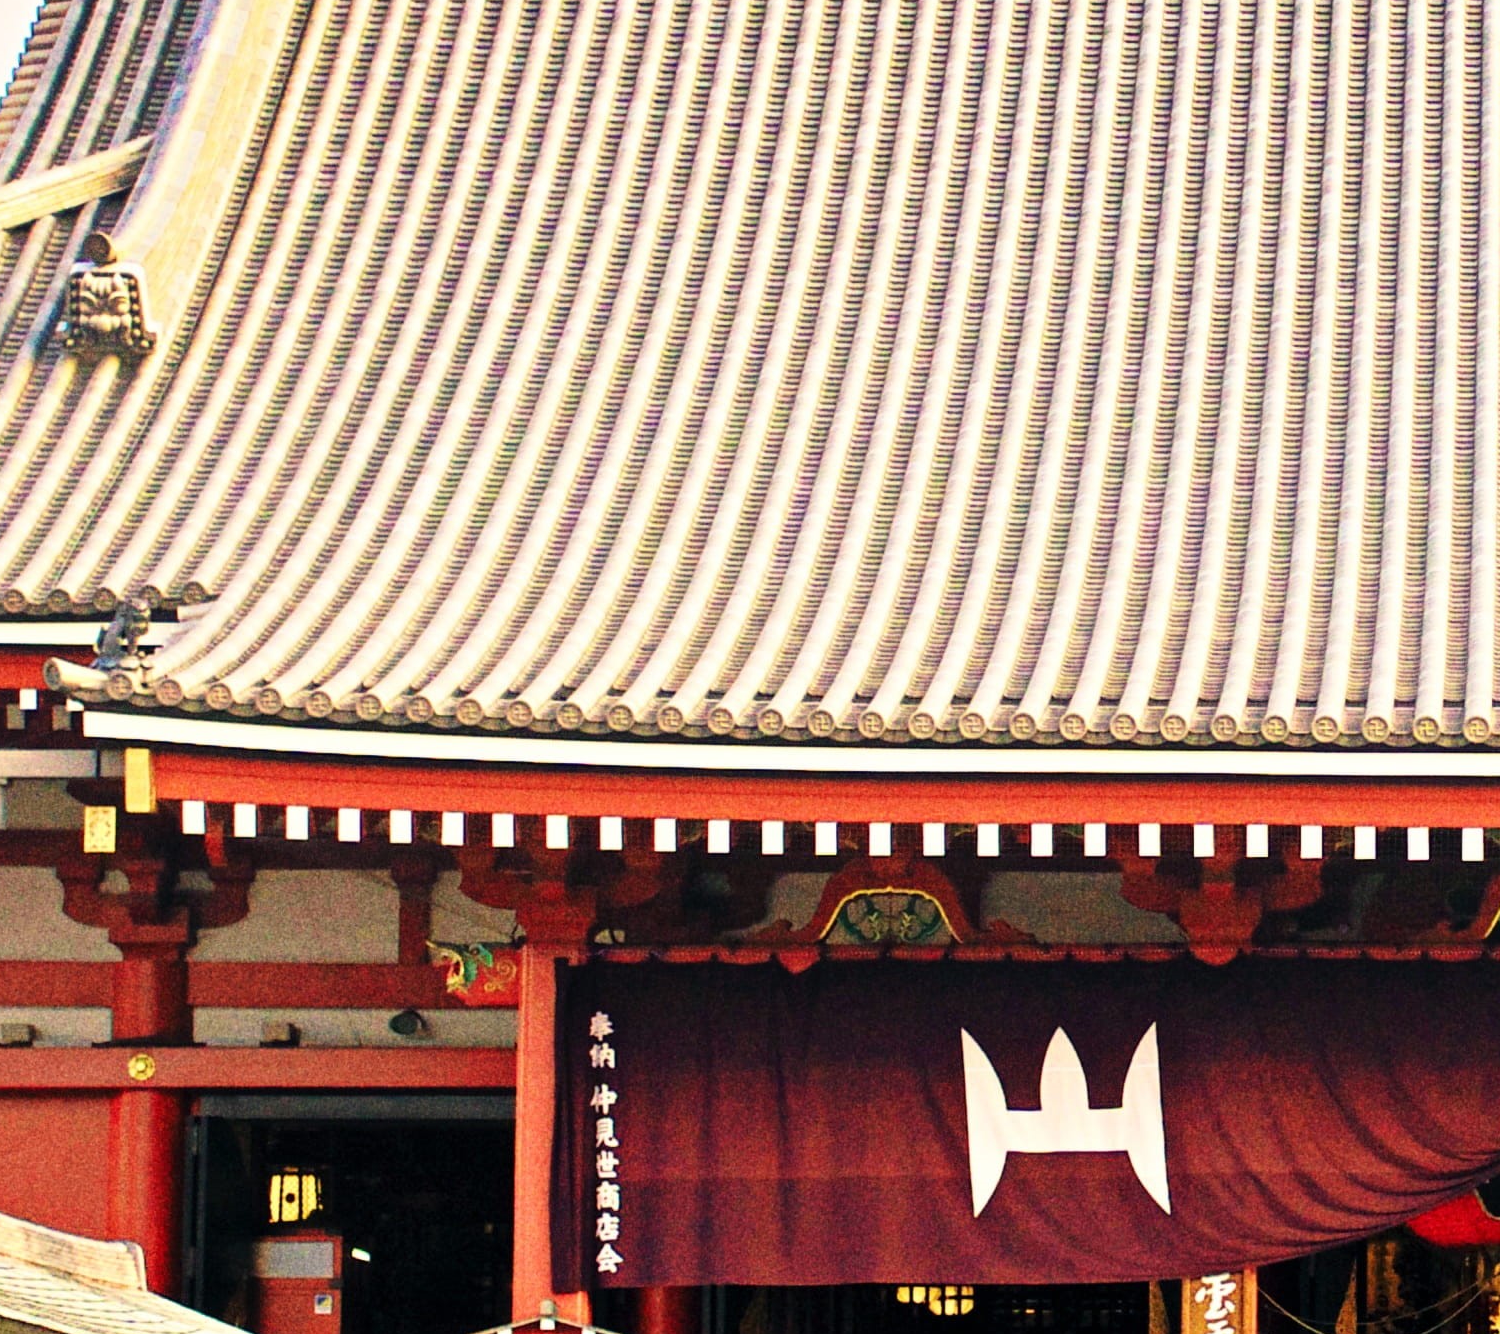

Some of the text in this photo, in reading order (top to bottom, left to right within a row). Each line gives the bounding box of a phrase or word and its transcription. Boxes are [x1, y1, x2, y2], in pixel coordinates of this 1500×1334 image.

[589, 1010, 623, 1273] 奉納 仲見世商店会
